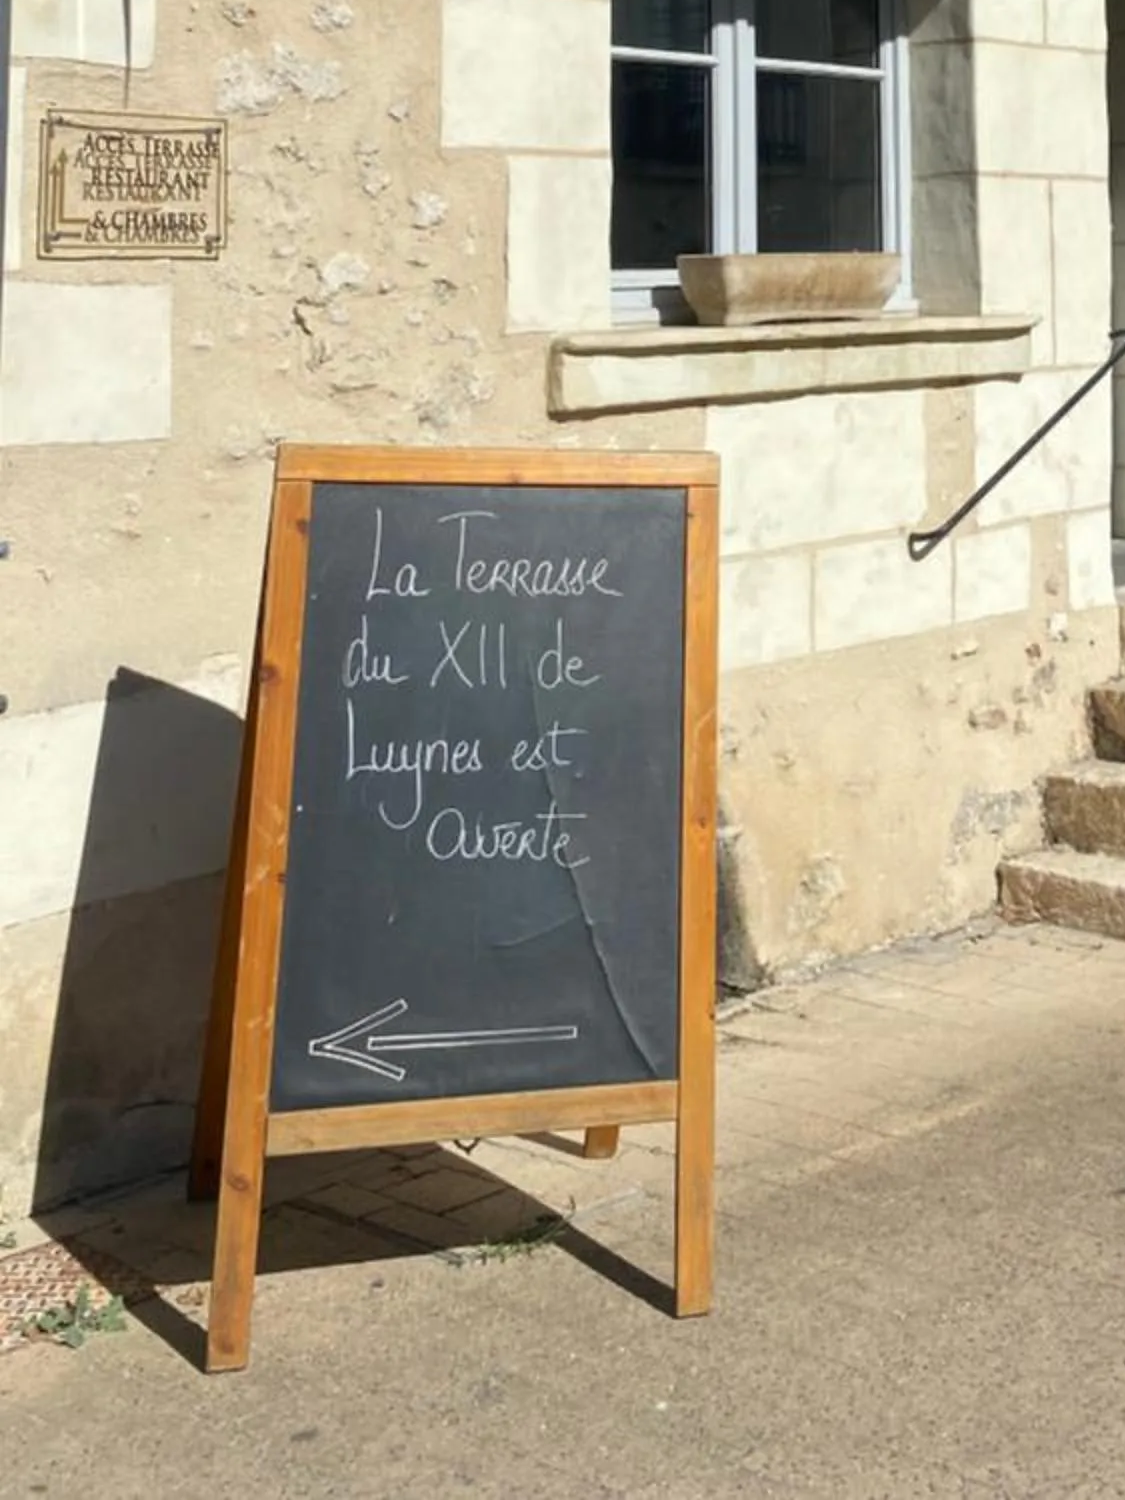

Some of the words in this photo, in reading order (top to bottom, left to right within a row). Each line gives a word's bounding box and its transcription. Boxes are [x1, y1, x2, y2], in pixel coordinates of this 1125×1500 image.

[111, 209, 208, 232] CHAMBRES
[366, 507, 431, 600] La
[342, 614, 409, 688] du
[430, 620, 506, 689] XII
[537, 617, 600, 690] de
[346, 698, 483, 829] Luynes
[511, 720, 589, 771] est
